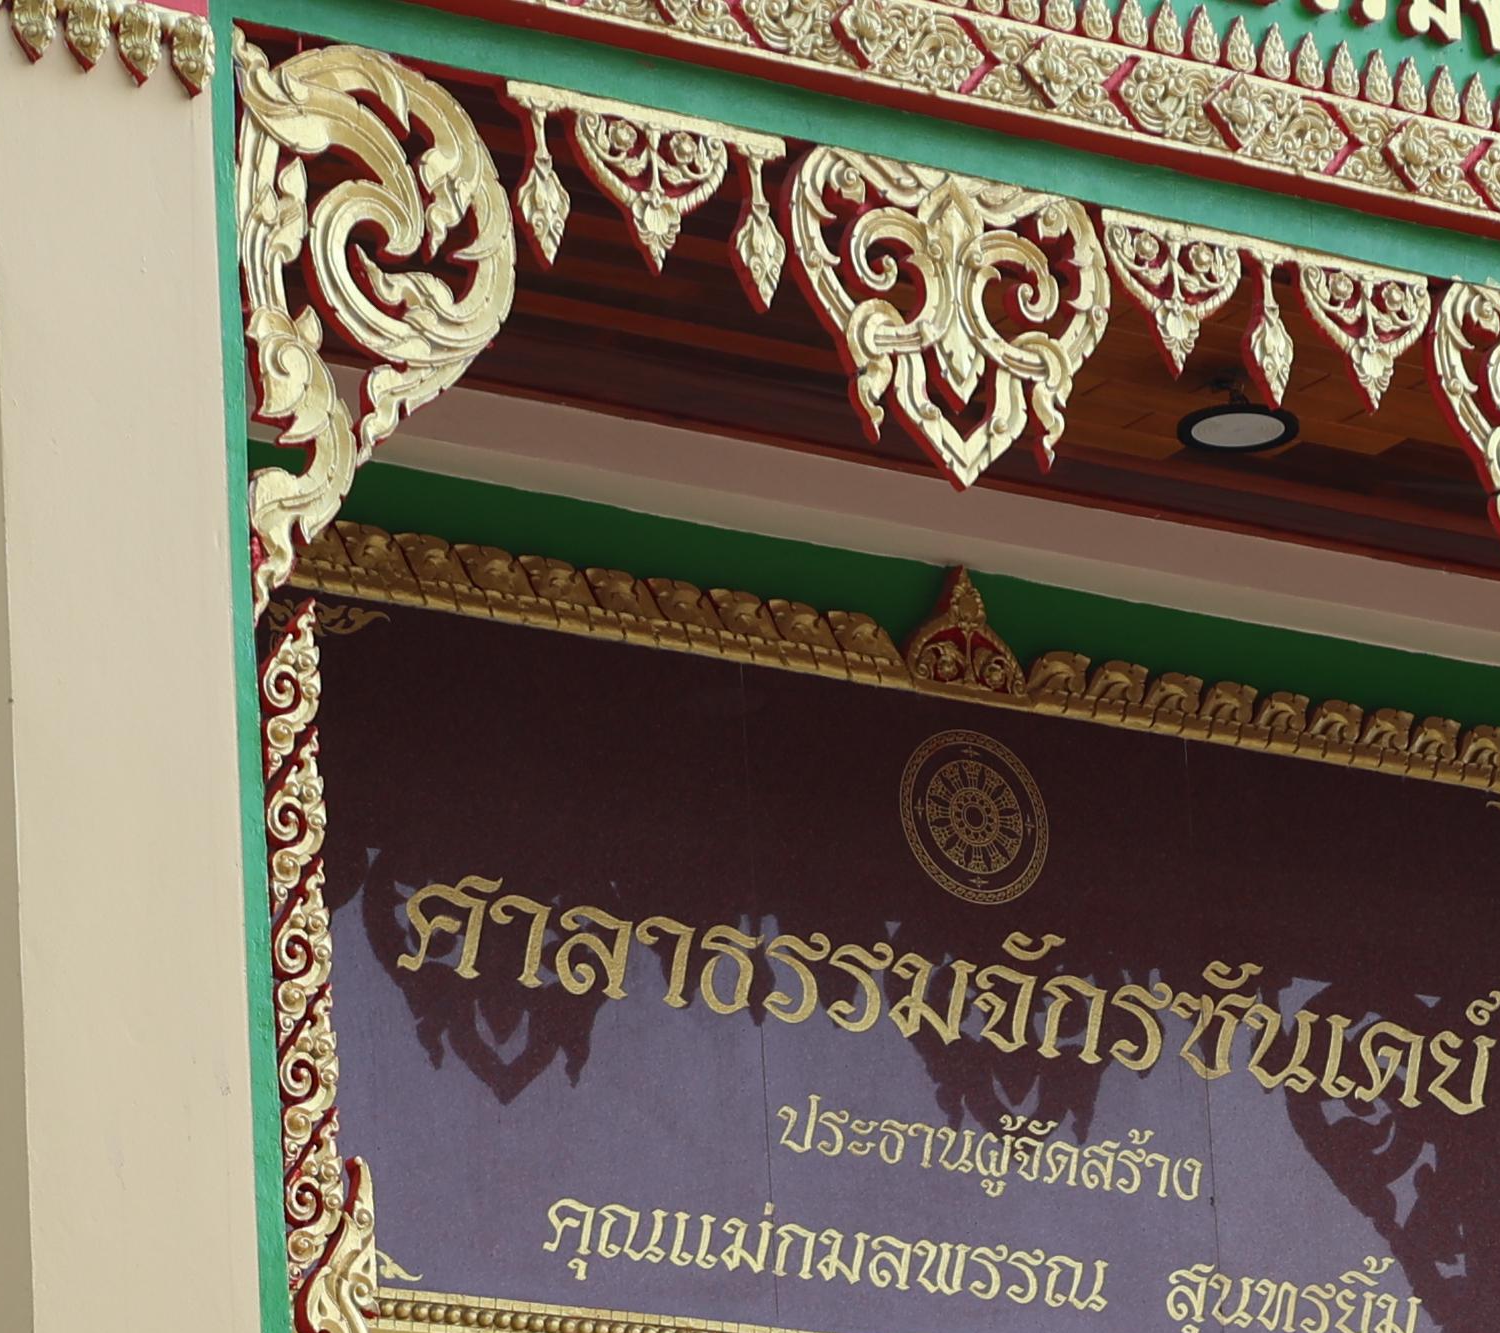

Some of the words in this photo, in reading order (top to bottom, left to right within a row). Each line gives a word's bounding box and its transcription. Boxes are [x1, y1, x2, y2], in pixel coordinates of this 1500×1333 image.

[777, 1094, 1204, 1200] ประธานผู้จัดสร้าง
[543, 1198, 1109, 1312] คุณแม่กมลพรรณ
